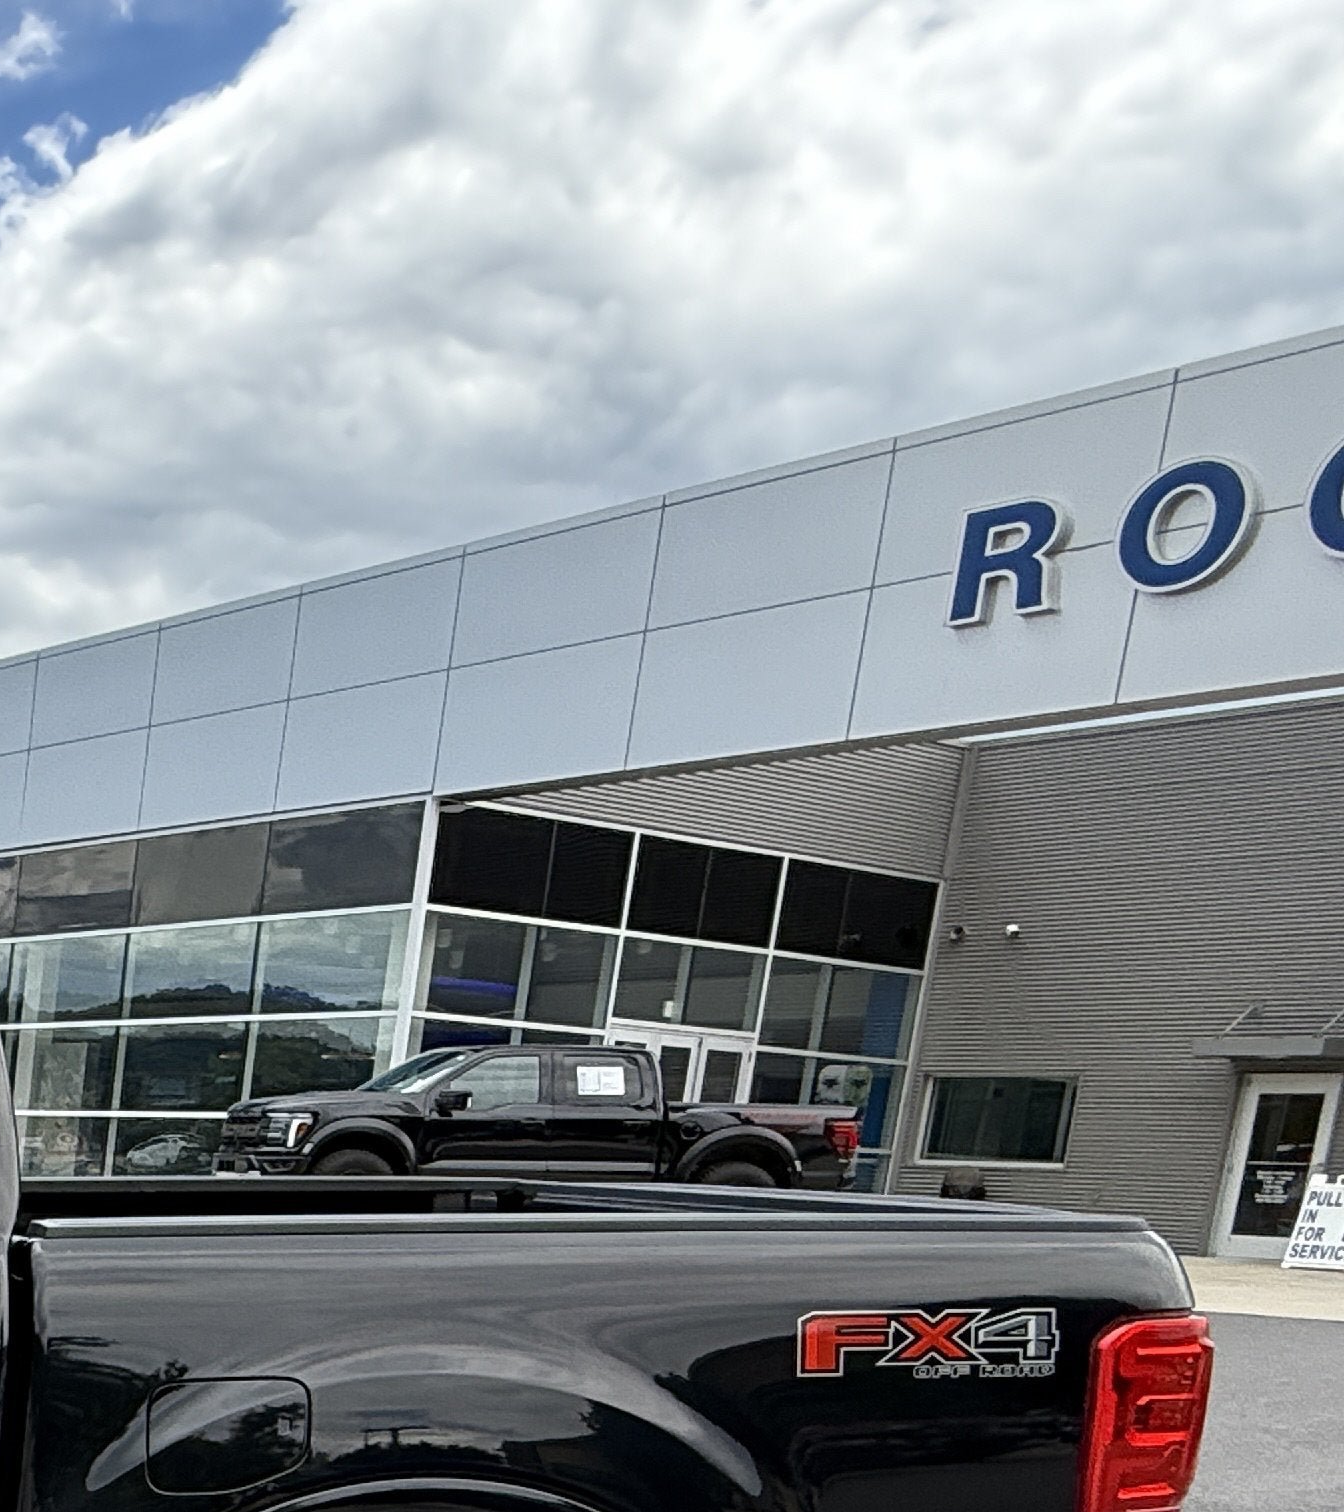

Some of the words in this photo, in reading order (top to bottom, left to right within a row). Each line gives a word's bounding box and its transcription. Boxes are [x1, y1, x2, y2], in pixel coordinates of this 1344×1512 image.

[944, 440, 1344, 628] RO
[1306, 1190, 1343, 1208] PULL
[1300, 1208, 1320, 1223] IN
[1295, 1226, 1326, 1242] FOR
[797, 1308, 1060, 1377] FX4
[913, 1365, 971, 1378] OFF
[979, 1365, 1056, 1378] ROAD
